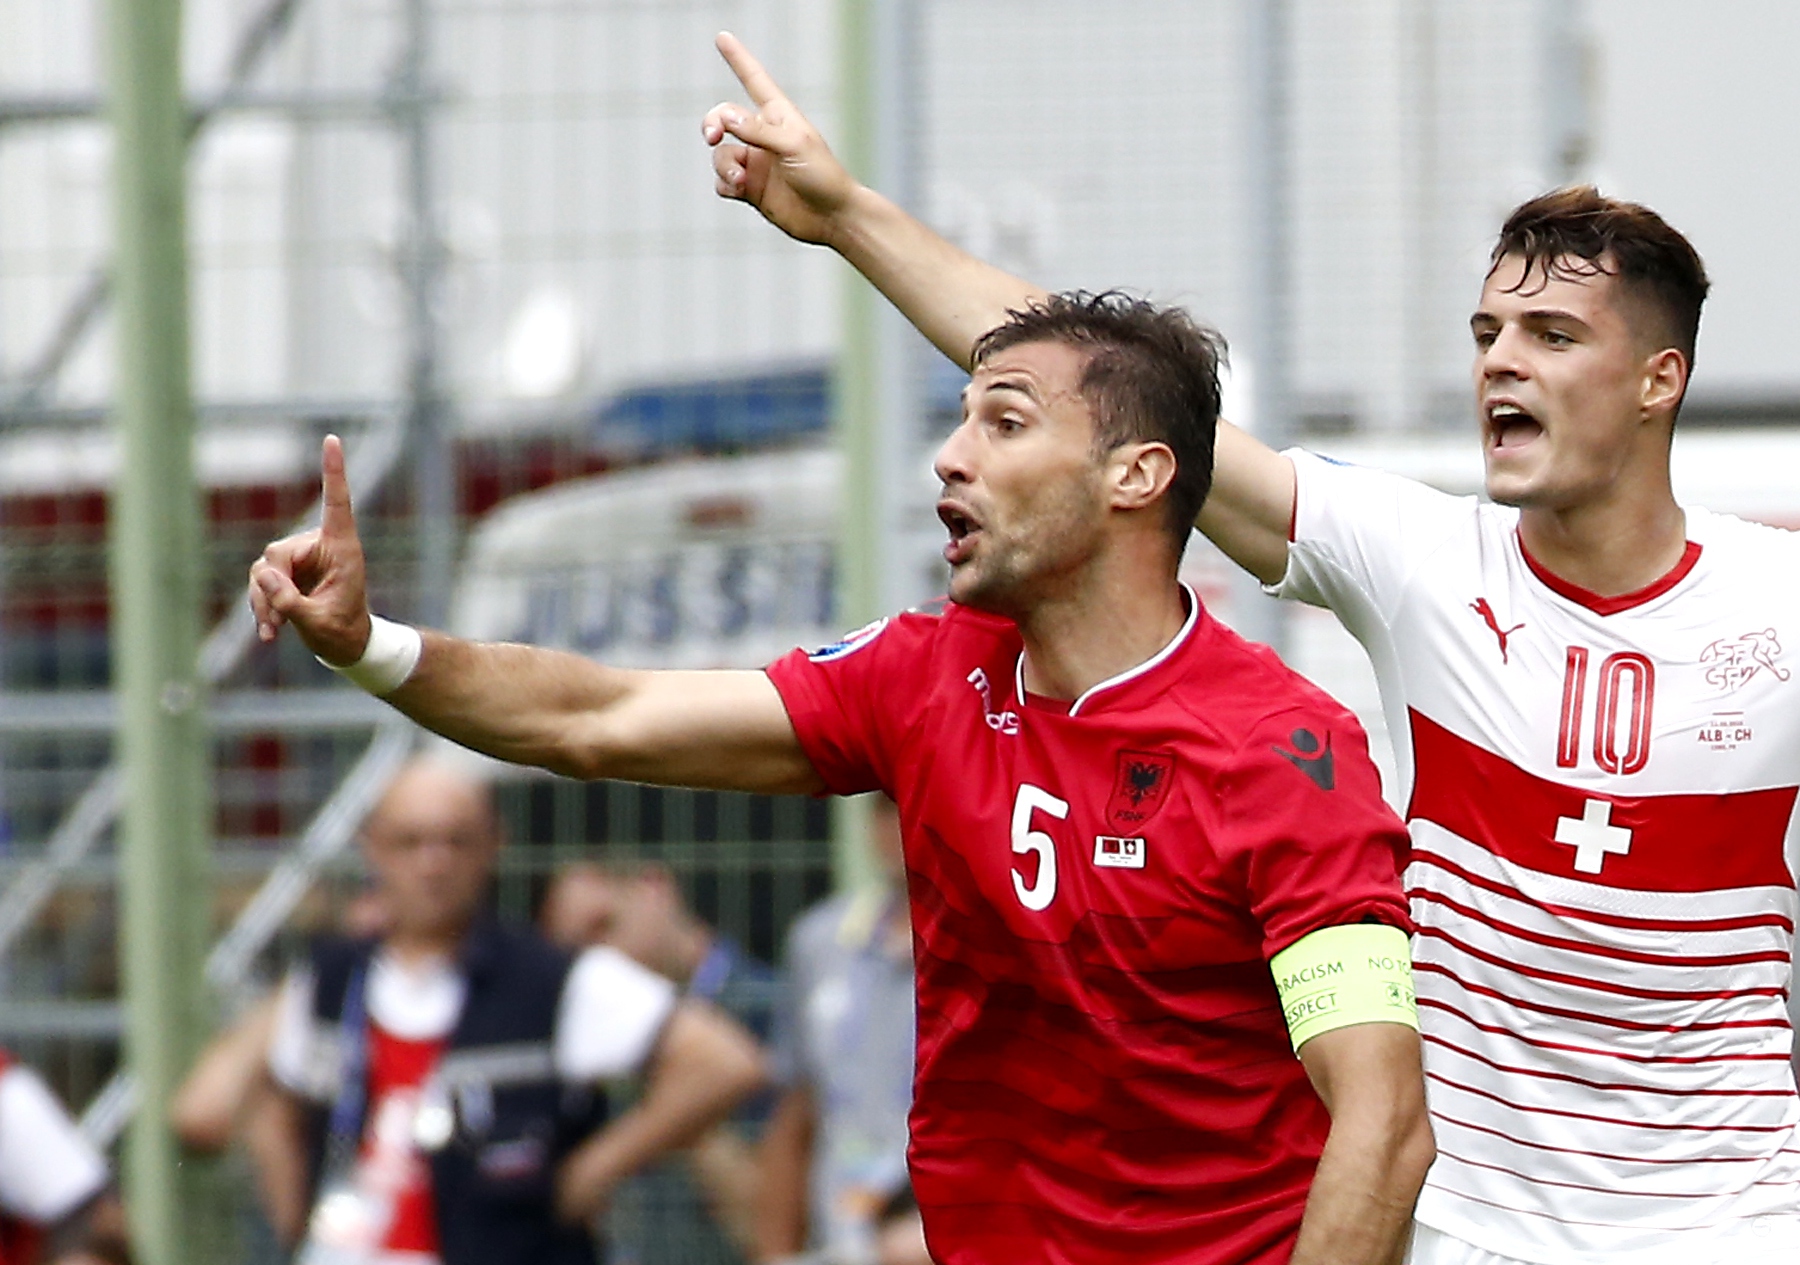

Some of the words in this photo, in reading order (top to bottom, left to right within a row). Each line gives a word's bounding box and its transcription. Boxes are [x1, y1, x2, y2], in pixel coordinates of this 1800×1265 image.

[1556, 645, 1655, 775] 10
[1697, 729, 1723, 742] ALB
[1734, 728, 1752, 741] CH
[1010, 782, 1069, 911] 5
[1282, 961, 1344, 993] RACISM
[1367, 956, 1394, 971] NO
[1286, 993, 1337, 1027] ESPECT
